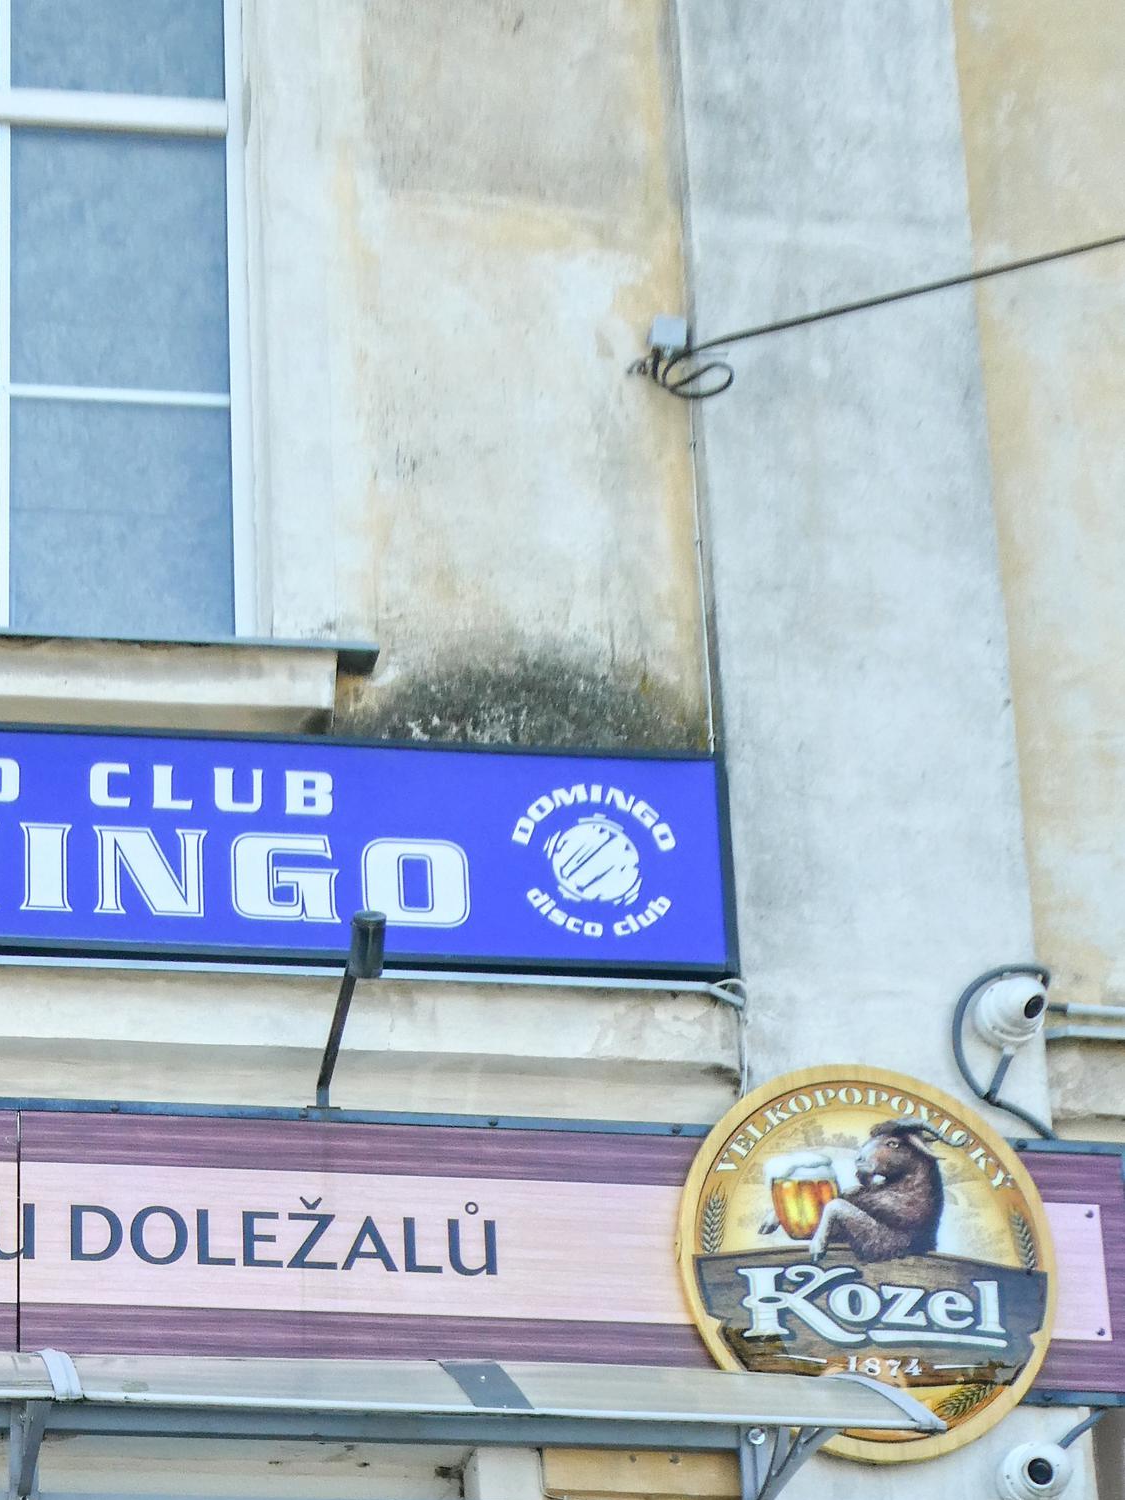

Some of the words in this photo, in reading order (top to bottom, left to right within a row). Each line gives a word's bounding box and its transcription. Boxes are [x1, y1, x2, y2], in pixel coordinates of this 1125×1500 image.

[89, 761, 335, 816] CLUB
[511, 782, 677, 853] DOMINGO
[525, 886, 604, 938] disco
[613, 893, 673, 938] club
[70, 1195, 498, 1277] DOLEŽALŮ
[737, 1264, 1008, 1348] Kozel
[847, 1355, 923, 1377] 1874
